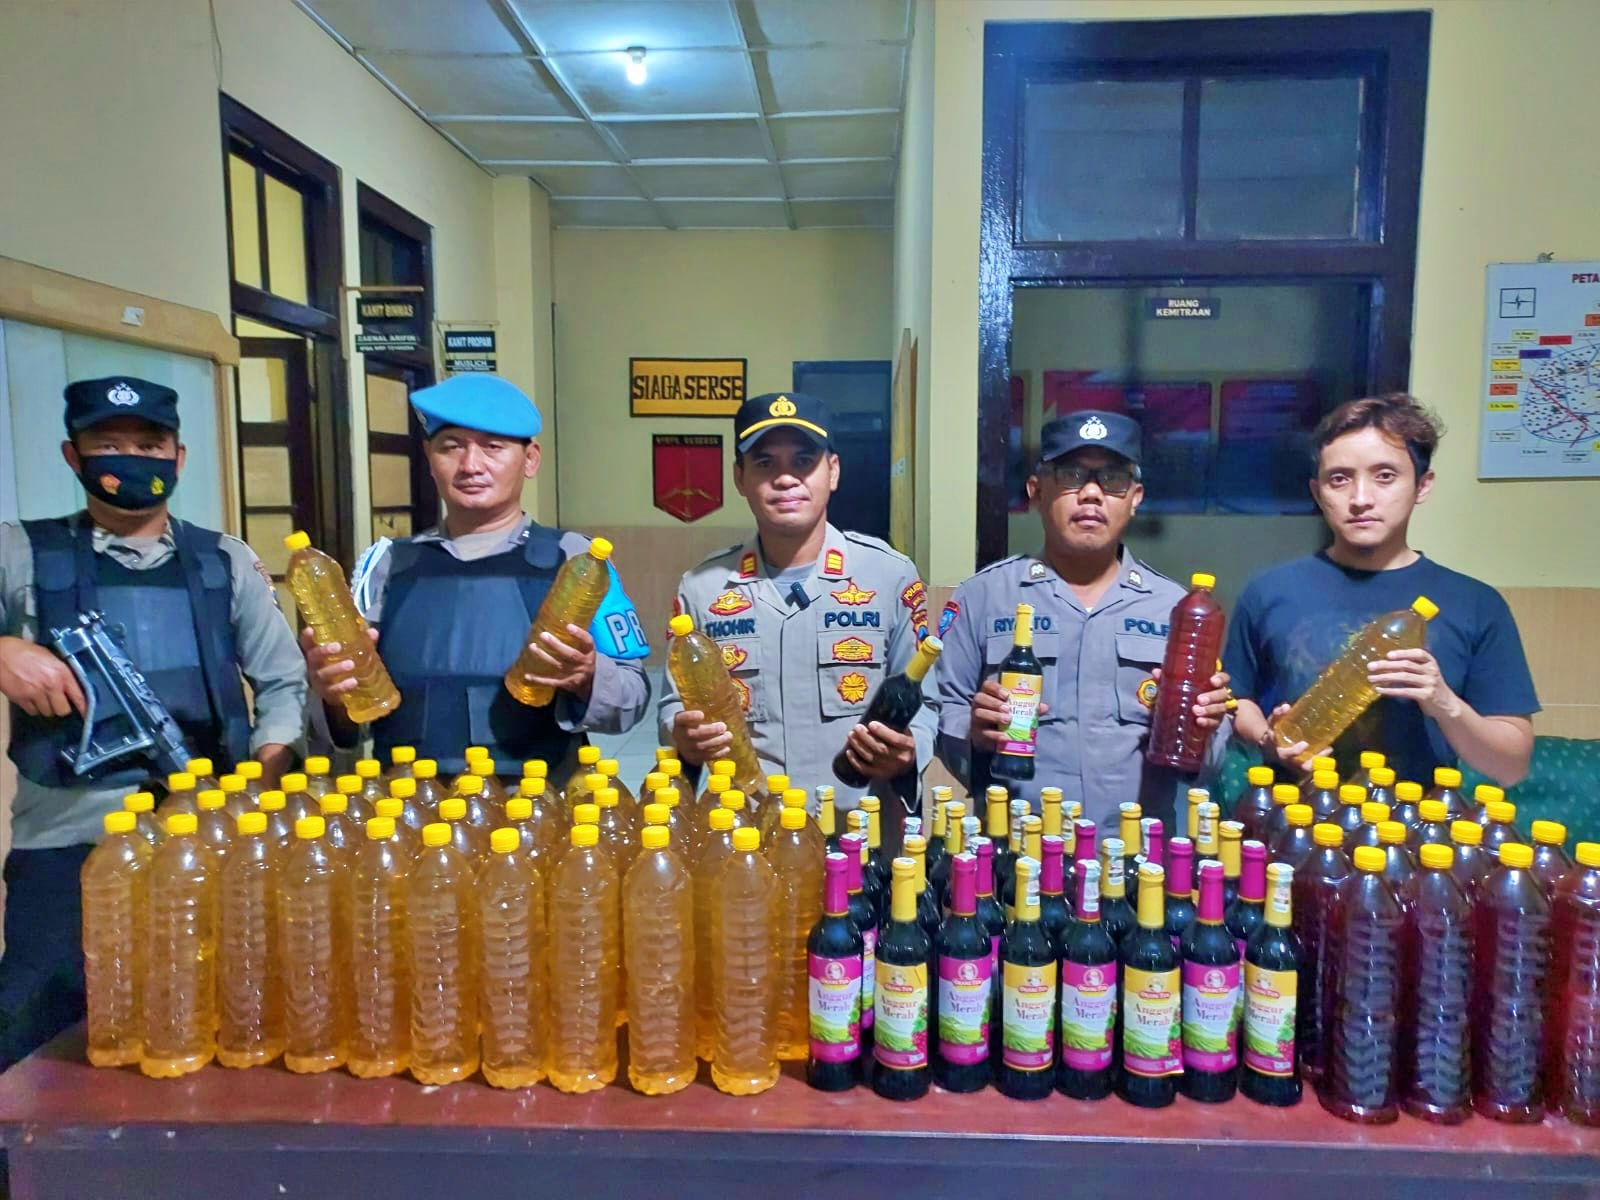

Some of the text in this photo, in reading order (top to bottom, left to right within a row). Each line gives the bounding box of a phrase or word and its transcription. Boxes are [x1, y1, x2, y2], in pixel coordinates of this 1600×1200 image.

[1571, 273, 1600, 284] PETA
[1168, 299, 1200, 308] RUANG
[1156, 308, 1212, 317] KEMITRAAN
[824, 611, 881, 628] POLRI
[994, 615, 1052, 633] RIYTO
[705, 617, 756, 638] THOHIR
